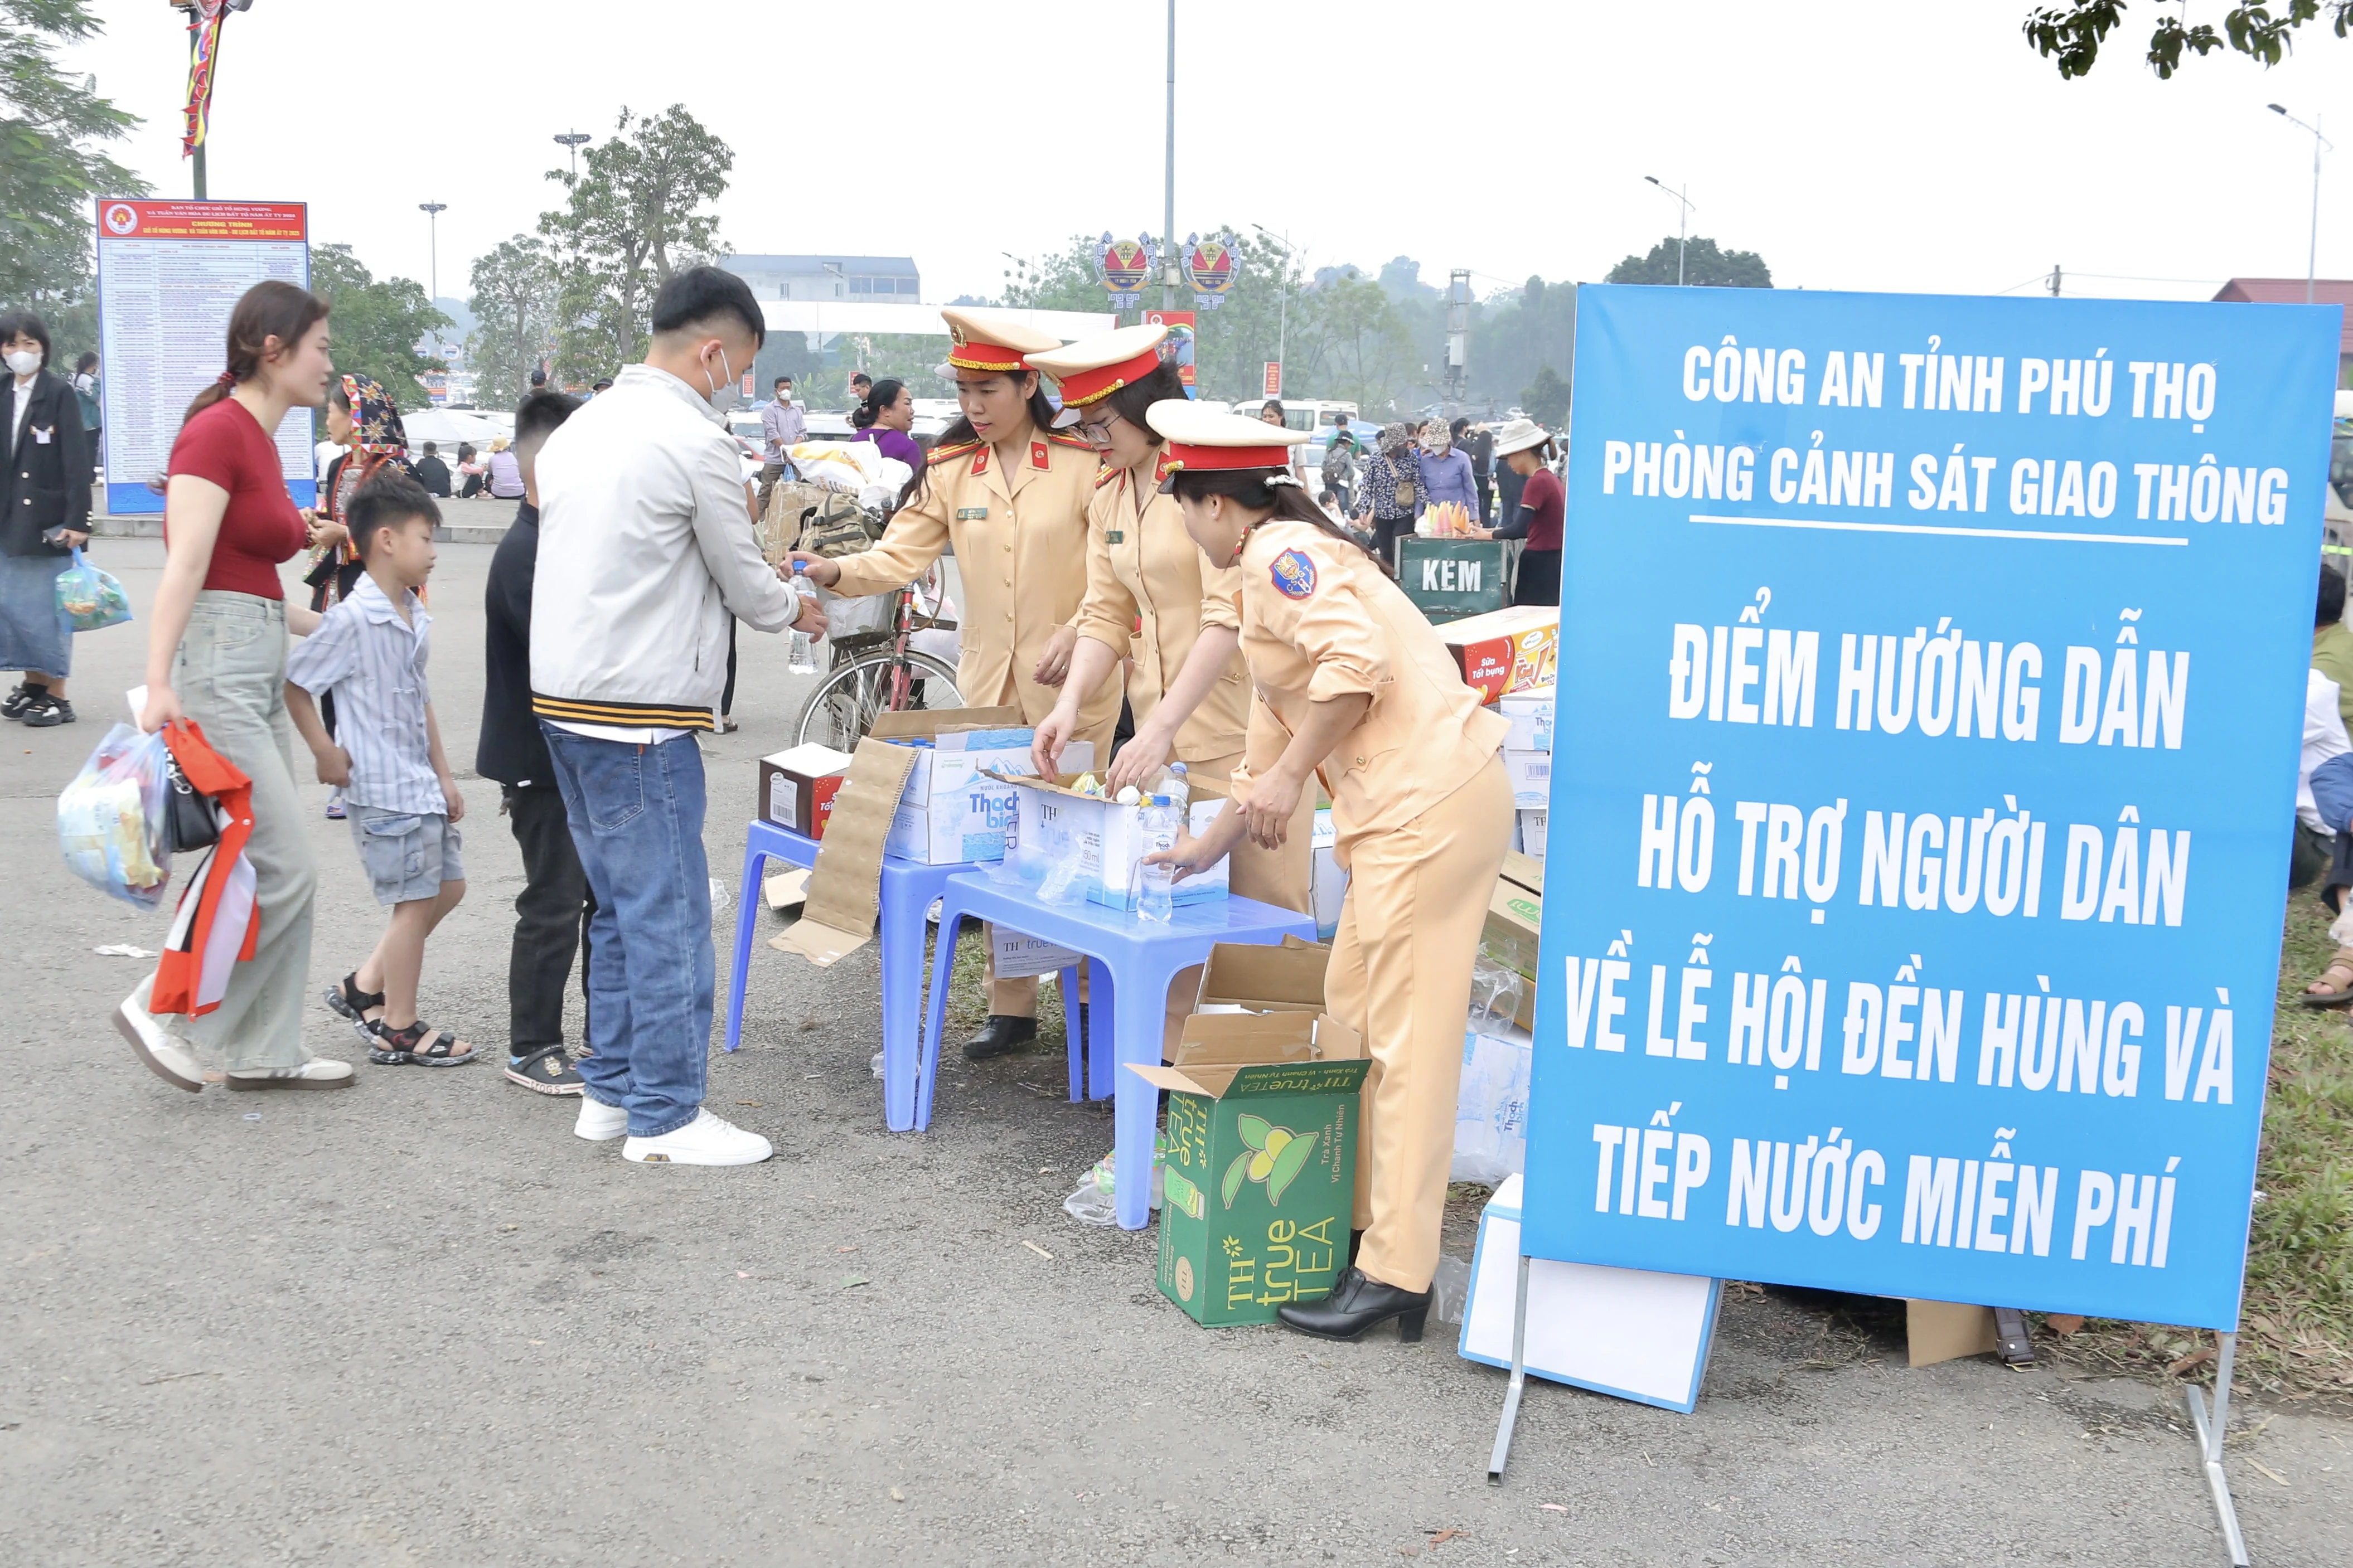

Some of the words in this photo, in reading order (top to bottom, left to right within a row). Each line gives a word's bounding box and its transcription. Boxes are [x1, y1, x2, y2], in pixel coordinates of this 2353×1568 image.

[1683, 335, 1805, 404] CÔNG
[1819, 351, 1884, 407] AN
[1900, 335, 2004, 412] TỈNH
[2018, 348, 2113, 416] PHÚ
[2129, 362, 2216, 433] THỌ
[1604, 430, 1754, 501] PHÒNG
[1770, 430, 1894, 507] CẢNH
[1909, 444, 1996, 512] SÁT
[2010, 458, 2117, 518] GIAO
[2134, 454, 2288, 525] THÔNG
[1422, 559, 1481, 592] KEM
[1472, 668, 1484, 679] Tốt
[1485, 666, 1505, 678] bụng
[1481, 657, 1495, 667] Sữa
[1669, 587, 1819, 727] ĐIỂM
[1836, 617, 2042, 741] HƯỚNG
[2060, 608, 2189, 749] DẪN
[1638, 761, 1715, 892] HỖ
[1736, 799, 1847, 924] TRỢ
[1860, 795, 2045, 916] NGƯỜI
[2061, 805, 2190, 926] DÂN
[1004, 941, 1019, 952] TH
[1566, 930, 1630, 1052] VỀ
[1646, 933, 1712, 1060] LỄ
[1728, 956, 1827, 1089] HỘI
[1842, 954, 1963, 1082] ĐỀN
[1978, 975, 2144, 1096] HÙNG
[2166, 988, 2232, 1104] VÀ
[1241, 1081, 1268, 1092] TEA
[1269, 1079, 1309, 1091] true
[1324, 1077, 1351, 1087] TH
[1168, 1094, 1185, 1153] TEA
[1180, 1099, 1197, 1166] true
[1195, 1108, 1207, 1149] TH
[1335, 1104, 1344, 1130] Nhiên
[1323, 1124, 1332, 1147] Xanh
[1334, 1132, 1344, 1143] Tự
[1321, 1149, 1330, 1164] Trà
[1332, 1145, 1341, 1172] Chanh
[1331, 1174, 1341, 1183] Vị
[1594, 1102, 1710, 1220] TIẾP
[1727, 1128, 1885, 1240] NƯỚC
[1902, 1128, 2058, 1256] MIỄN
[2072, 1157, 2180, 1267] PHÍ
[1256, 1220, 1296, 1306] true
[1294, 1216, 1335, 1301] TEA
[1228, 1257, 1255, 1310] TH
